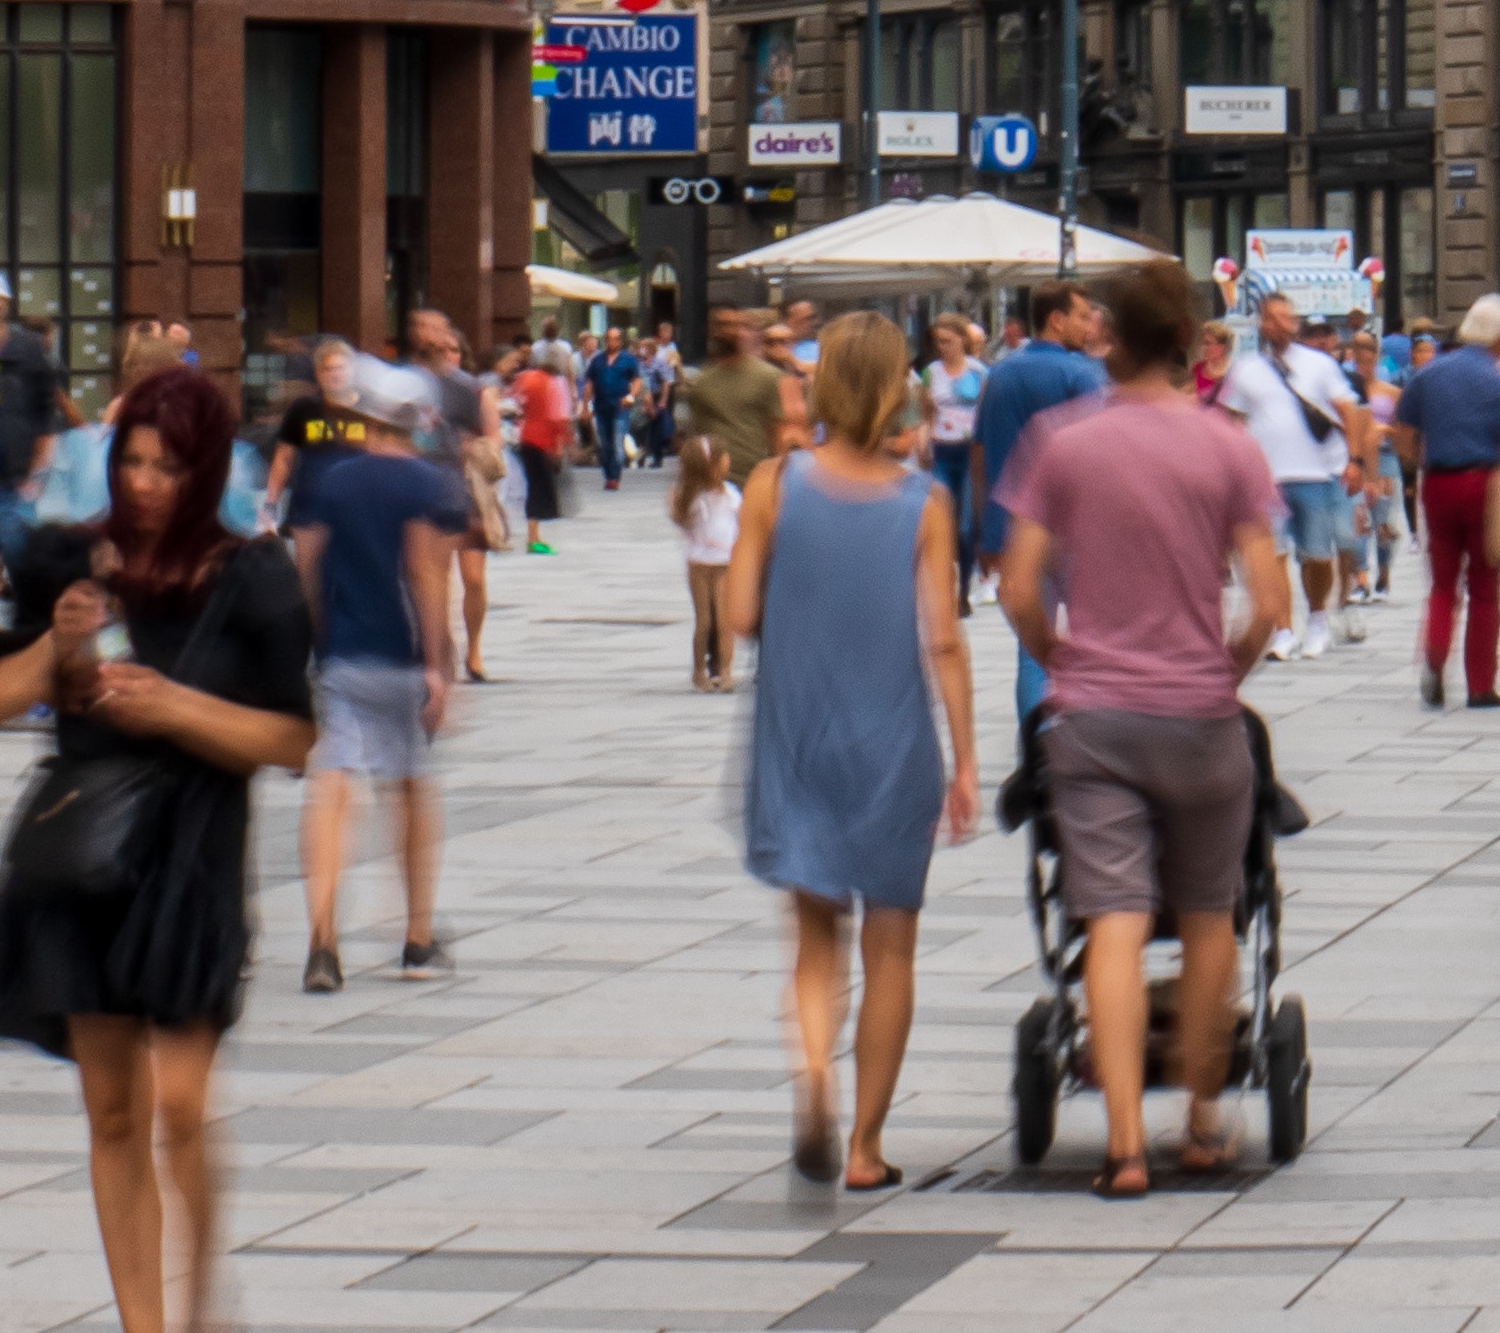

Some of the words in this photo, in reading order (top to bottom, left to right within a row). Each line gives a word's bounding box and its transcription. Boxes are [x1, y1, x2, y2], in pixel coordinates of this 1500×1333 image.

[565, 25, 681, 52] CAMBIO
[554, 65, 696, 99] CHANGE
[754, 132, 834, 154] claire's
[994, 129, 1029, 167] U
